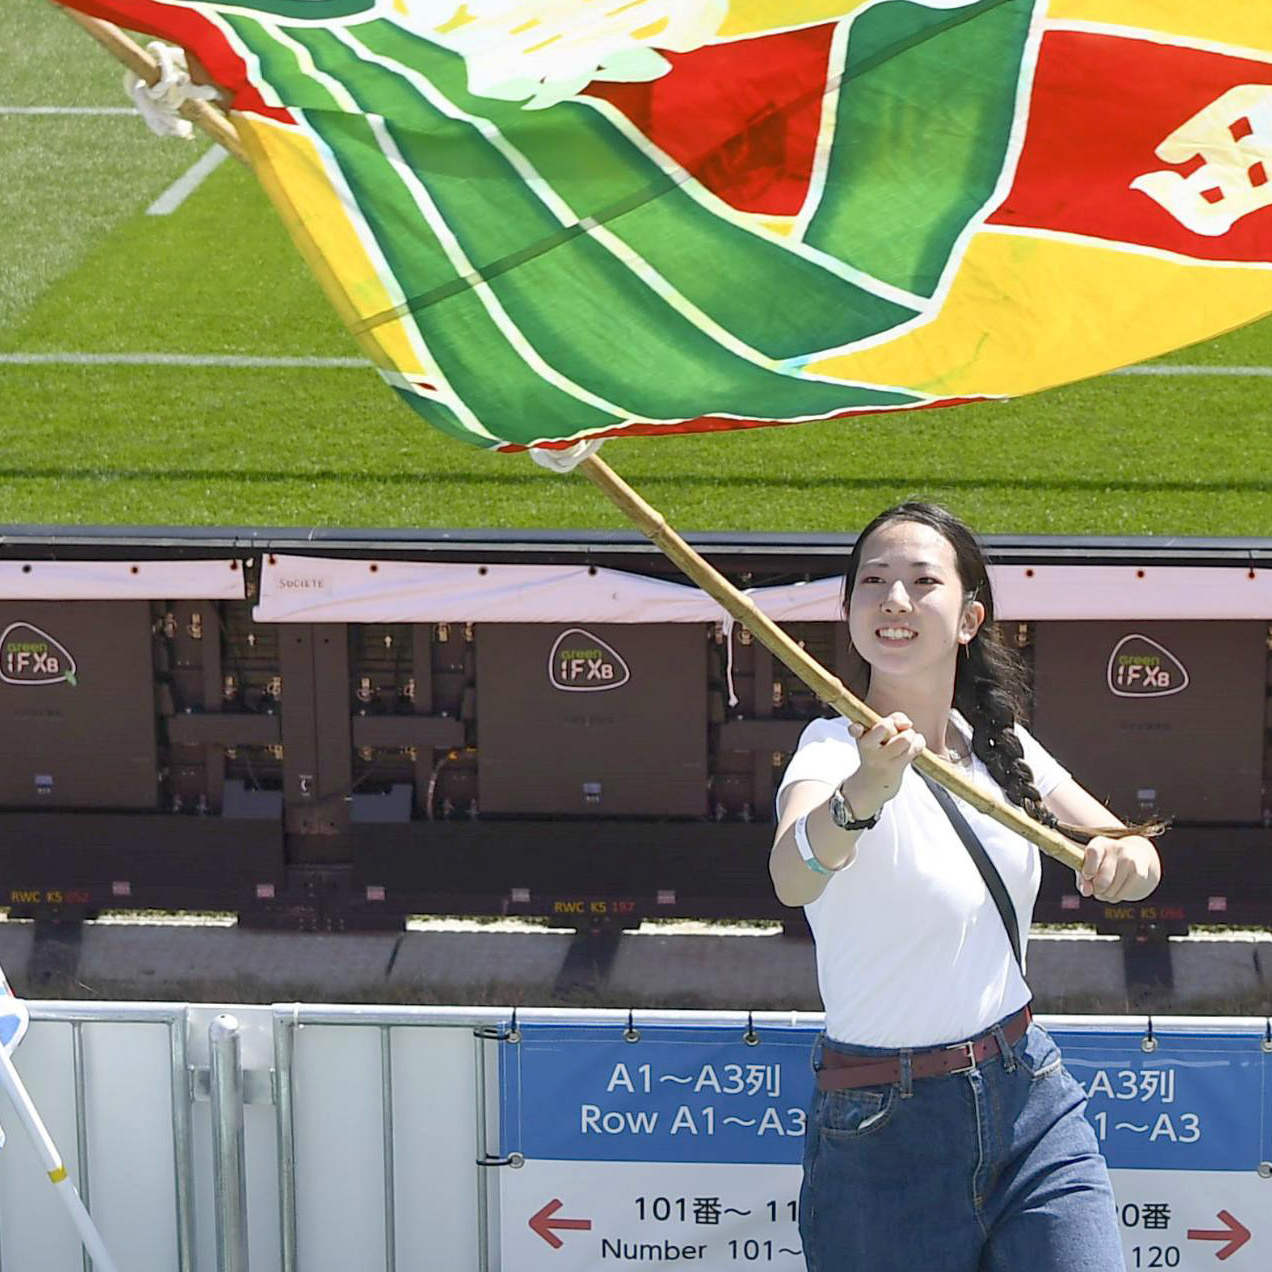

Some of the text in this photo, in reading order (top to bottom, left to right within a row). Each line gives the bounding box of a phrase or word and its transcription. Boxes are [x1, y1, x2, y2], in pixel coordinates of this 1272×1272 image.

[11, 891, 41, 904] RWC
[554, 901, 584, 913] RWC
[1105, 907, 1135, 919] RWC
[1079, 1069, 1175, 1103] A3列
[580, 1104, 807, 1137] Row A1～A3
[1115, 1203, 1171, 1229] 0番
[601, 1238, 708, 1261] Number
[1132, 1246, 1181, 1268] 120
